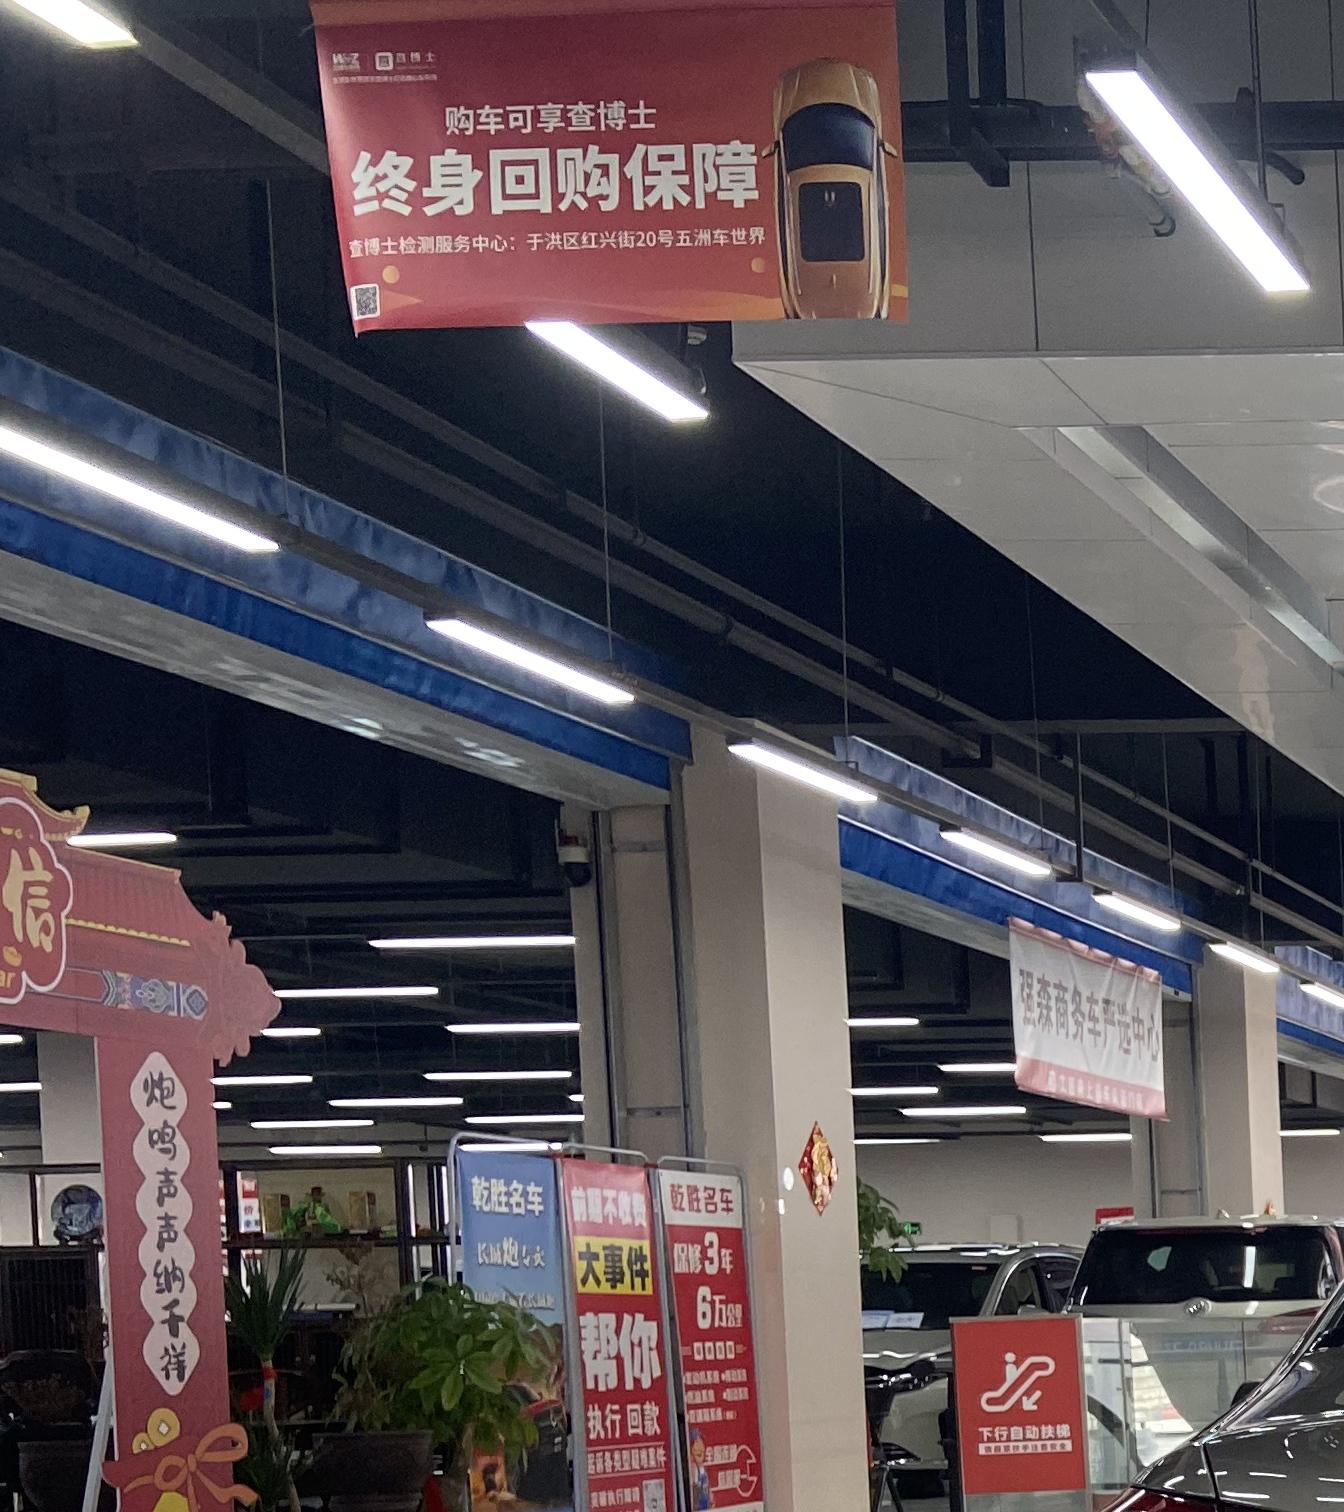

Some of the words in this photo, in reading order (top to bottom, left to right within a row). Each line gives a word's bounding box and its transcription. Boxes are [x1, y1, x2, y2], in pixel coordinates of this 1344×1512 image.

[445, 100, 657, 137] 购车可享查博士
[351, 140, 761, 218] 终身回购保障
[578, 1242, 650, 1292] 大事件
[673, 1231, 734, 1276] 保修3年
[580, 1311, 663, 1393] 帮你
[587, 1402, 622, 1440] 执行
[626, 1400, 661, 1437] 回款
[978, 1424, 1071, 1441] 下行自动扶梯
